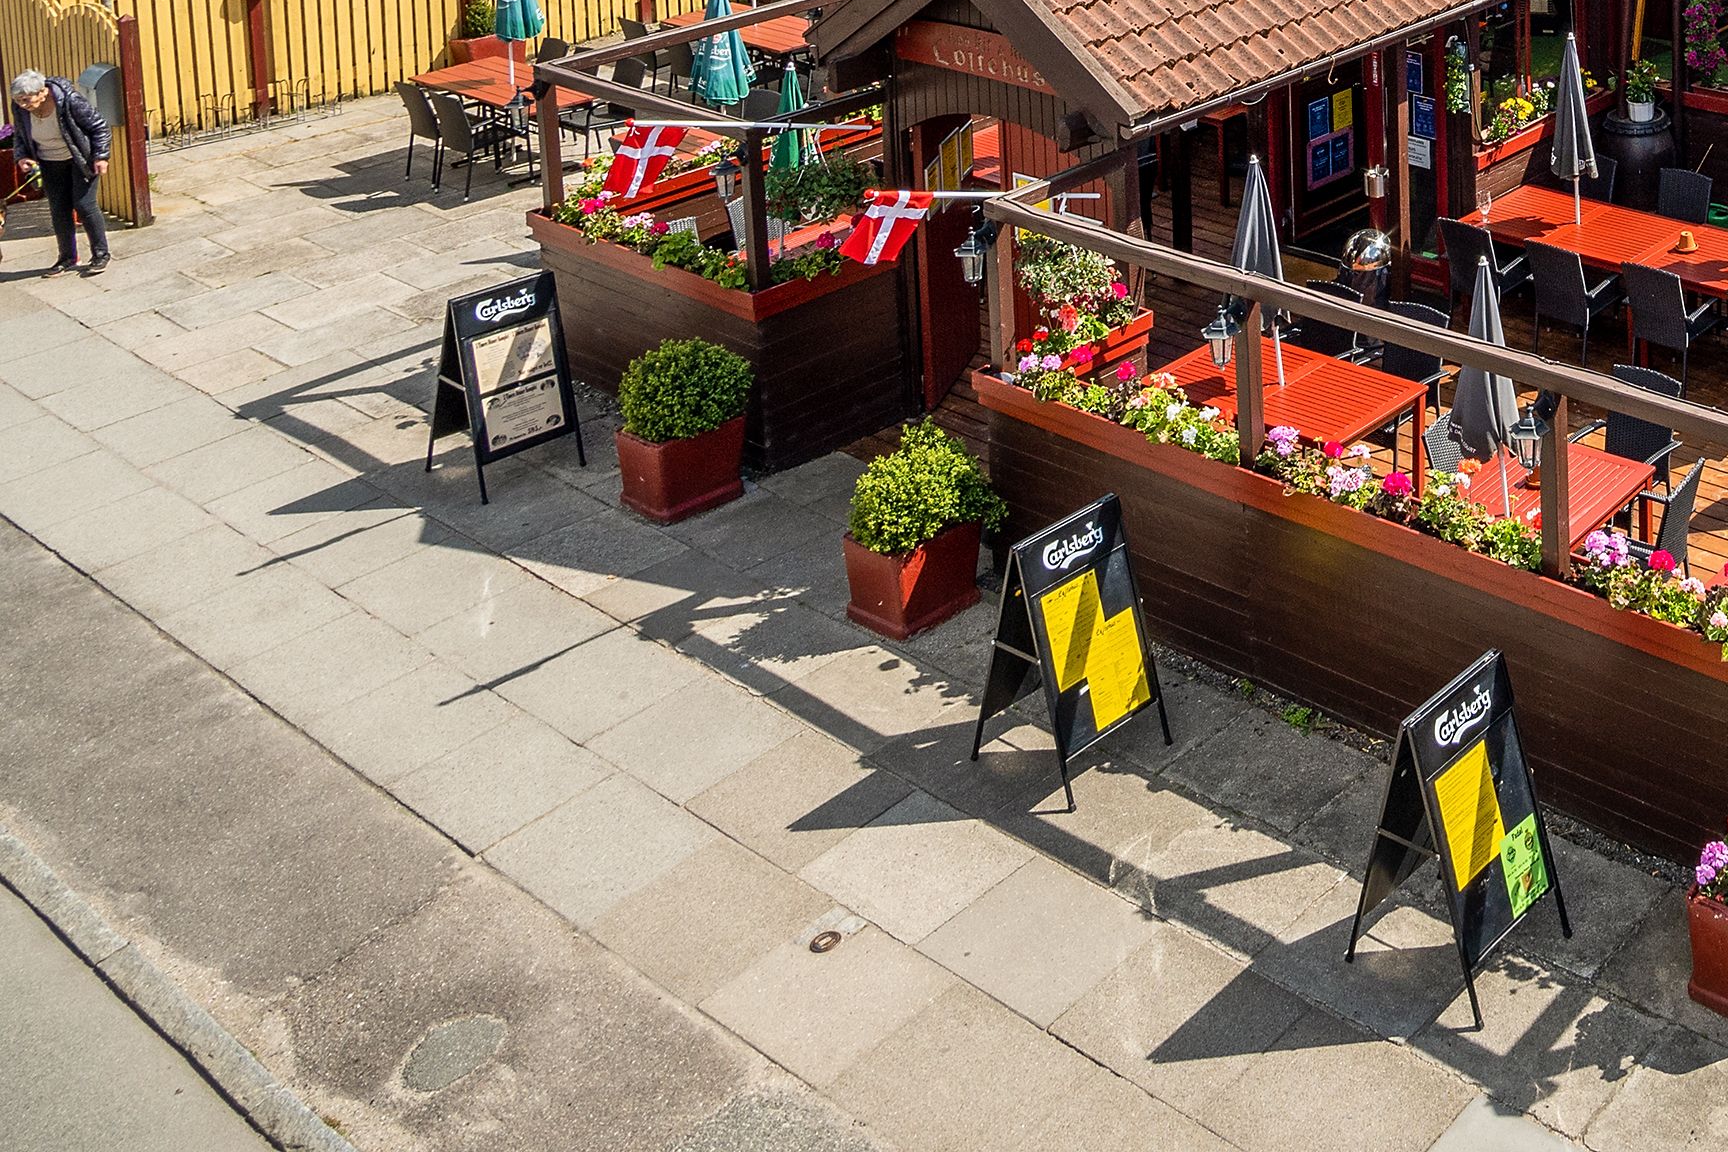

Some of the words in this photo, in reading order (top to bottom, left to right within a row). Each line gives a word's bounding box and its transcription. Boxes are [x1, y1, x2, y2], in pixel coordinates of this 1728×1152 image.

[476, 288, 536, 321] Carlsberg
[1043, 521, 1103, 570] Carlsberg
[1435, 684, 1491, 745] Carlsberg
